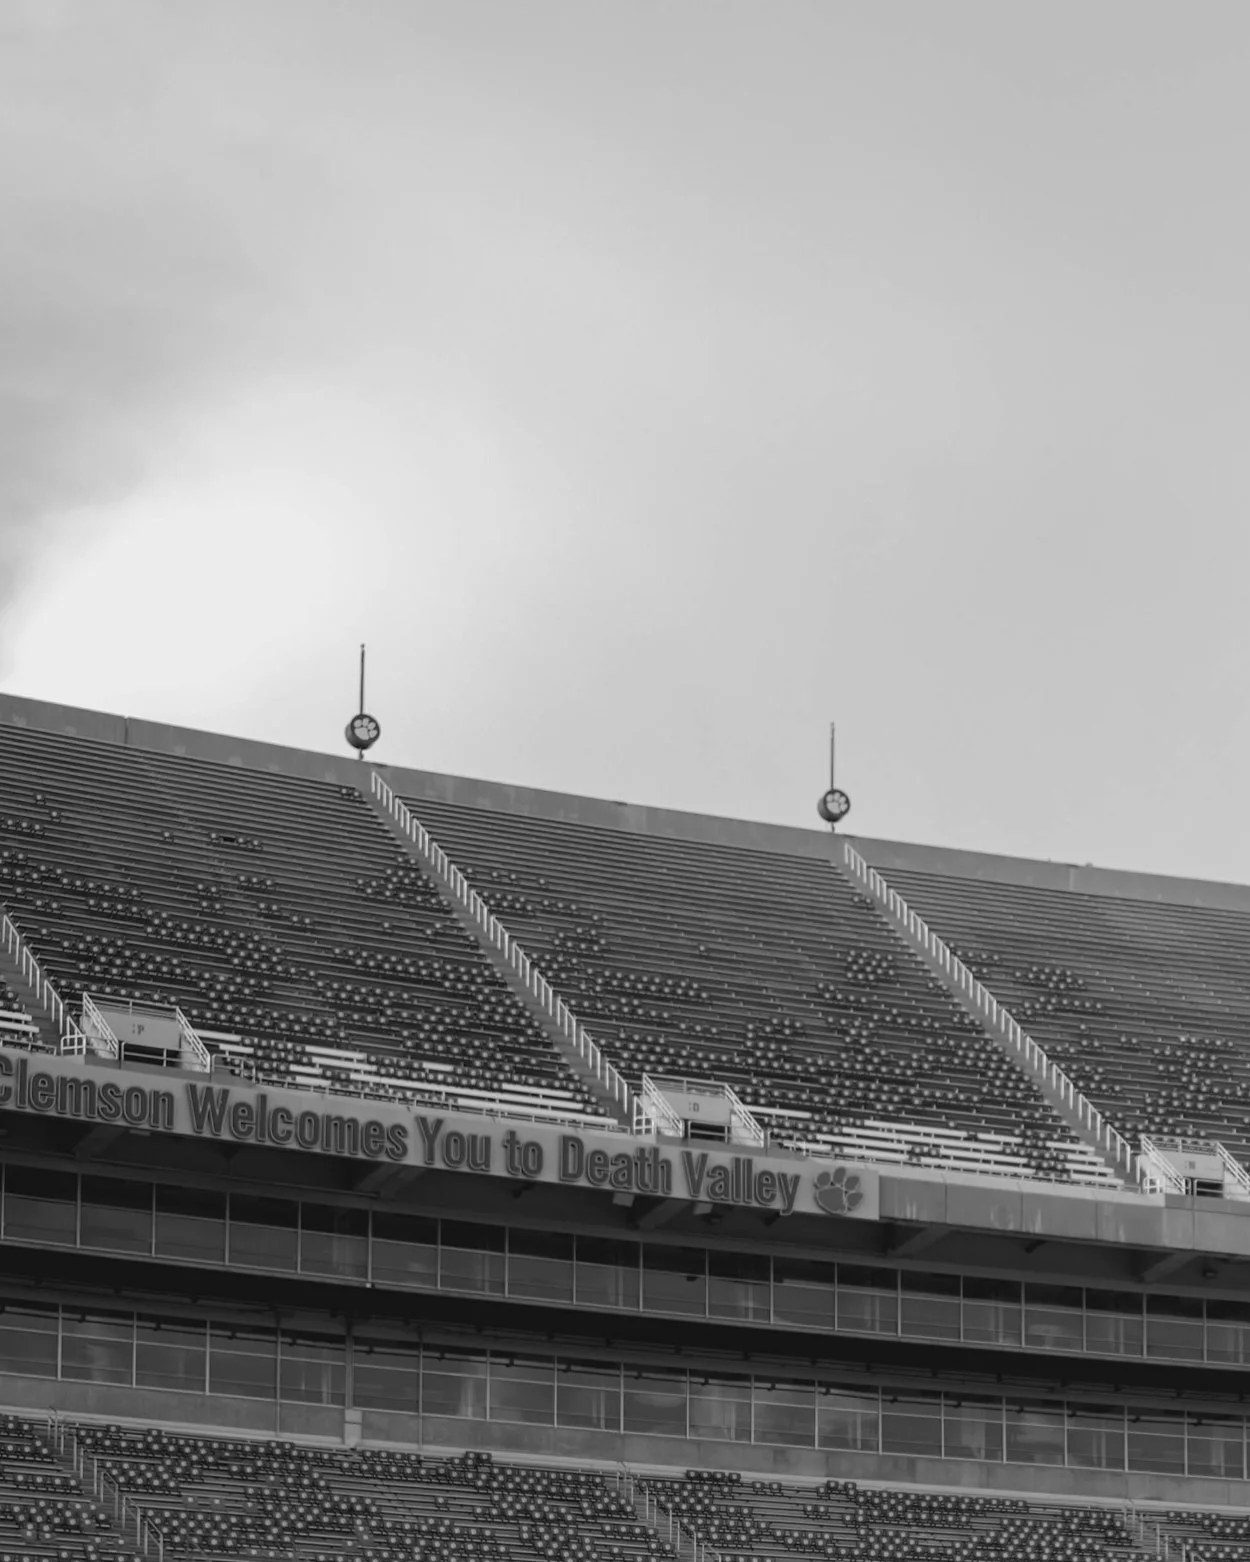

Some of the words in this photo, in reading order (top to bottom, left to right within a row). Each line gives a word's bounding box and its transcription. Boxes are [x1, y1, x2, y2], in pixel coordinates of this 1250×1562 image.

[186, 1083, 409, 1161] Welcomes
[415, 1116, 492, 1172] You
[503, 1130, 544, 1177] to
[558, 1134, 672, 1195] Death
[681, 1150, 801, 1216] Valley
